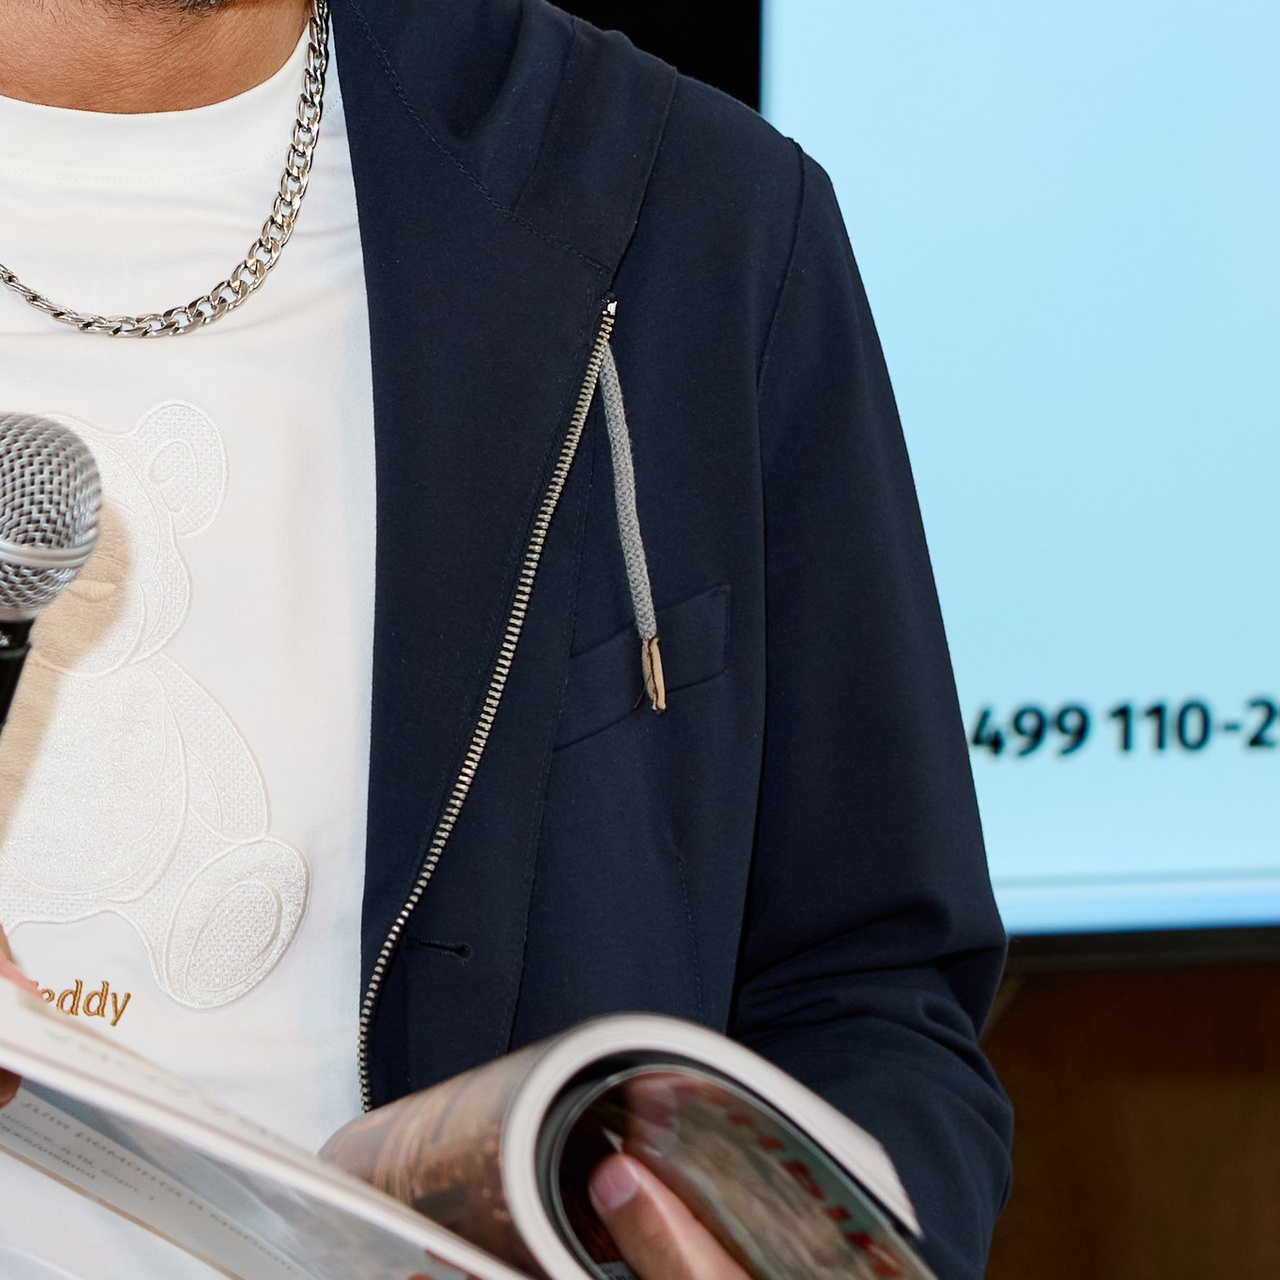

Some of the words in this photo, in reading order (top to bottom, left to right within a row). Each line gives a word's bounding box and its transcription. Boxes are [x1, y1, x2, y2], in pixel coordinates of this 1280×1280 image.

[973, 703, 1092, 757] 499
[1109, 696, 1280, 753] 110-2
[32, 979, 131, 1027] eddy
